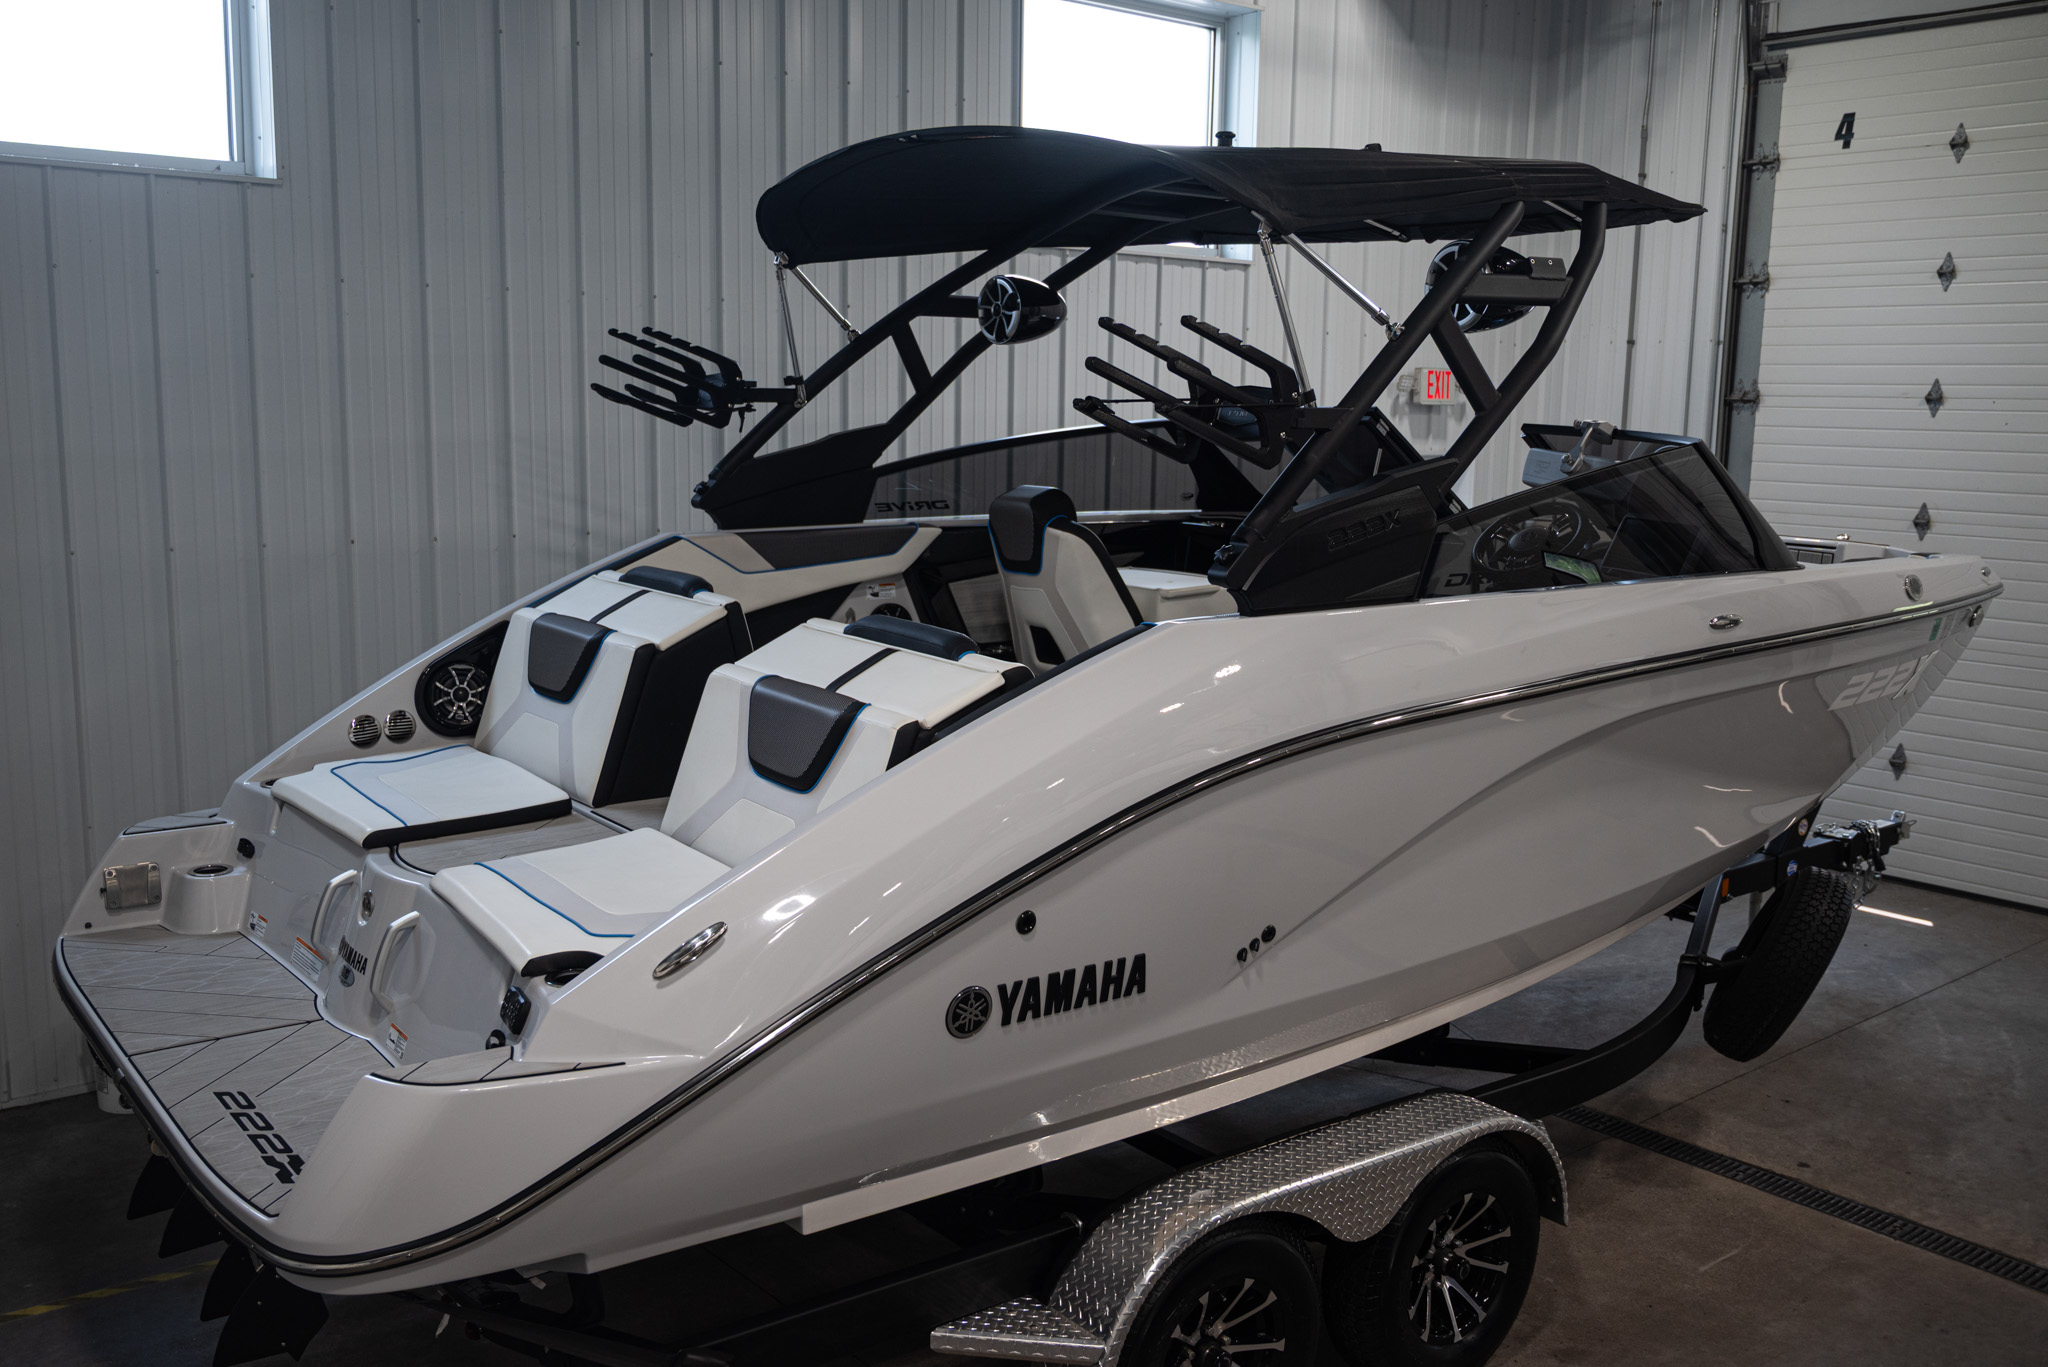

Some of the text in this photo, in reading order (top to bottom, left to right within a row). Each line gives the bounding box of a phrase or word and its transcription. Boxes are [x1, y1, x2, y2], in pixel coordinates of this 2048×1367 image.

[1834, 112, 1856, 149] 4
[1427, 370, 1451, 400] EXIT
[1327, 508, 1401, 551] 222X
[1827, 650, 1940, 712] 222X
[341, 939, 369, 976] YAMAHA
[997, 953, 1147, 1027] YAMAHA
